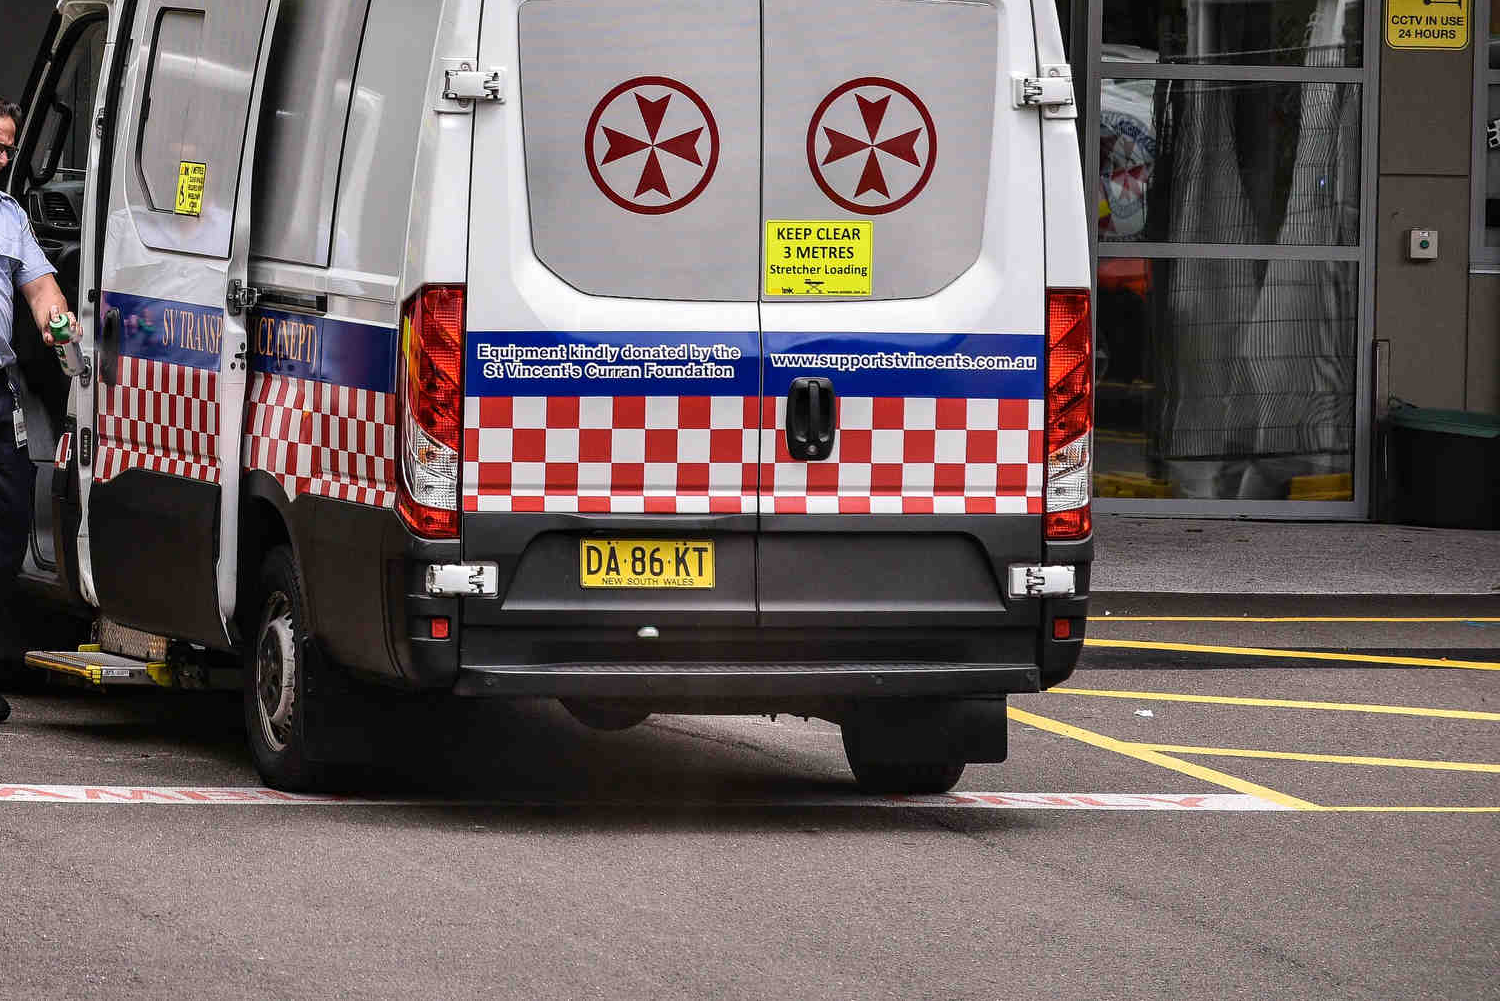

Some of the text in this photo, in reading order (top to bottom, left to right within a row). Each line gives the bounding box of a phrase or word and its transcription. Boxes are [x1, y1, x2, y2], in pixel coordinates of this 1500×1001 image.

[1391, 15, 1465, 26] CCTV IN USE
[1398, 29, 1457, 40] 24 HOURS
[777, 227, 861, 240] KEEP CLEAR
[783, 246, 854, 259] 3 METRES
[770, 264, 868, 277] Stretcher Loading
[477, 344, 741, 362] Equipment kindly donated by the
[770, 352, 1037, 372] www.supportstvincents.com.au
[483, 363, 734, 379] St Vincent's Curran Foundation
[601, 577, 694, 587] NEW SOUTH WALES
